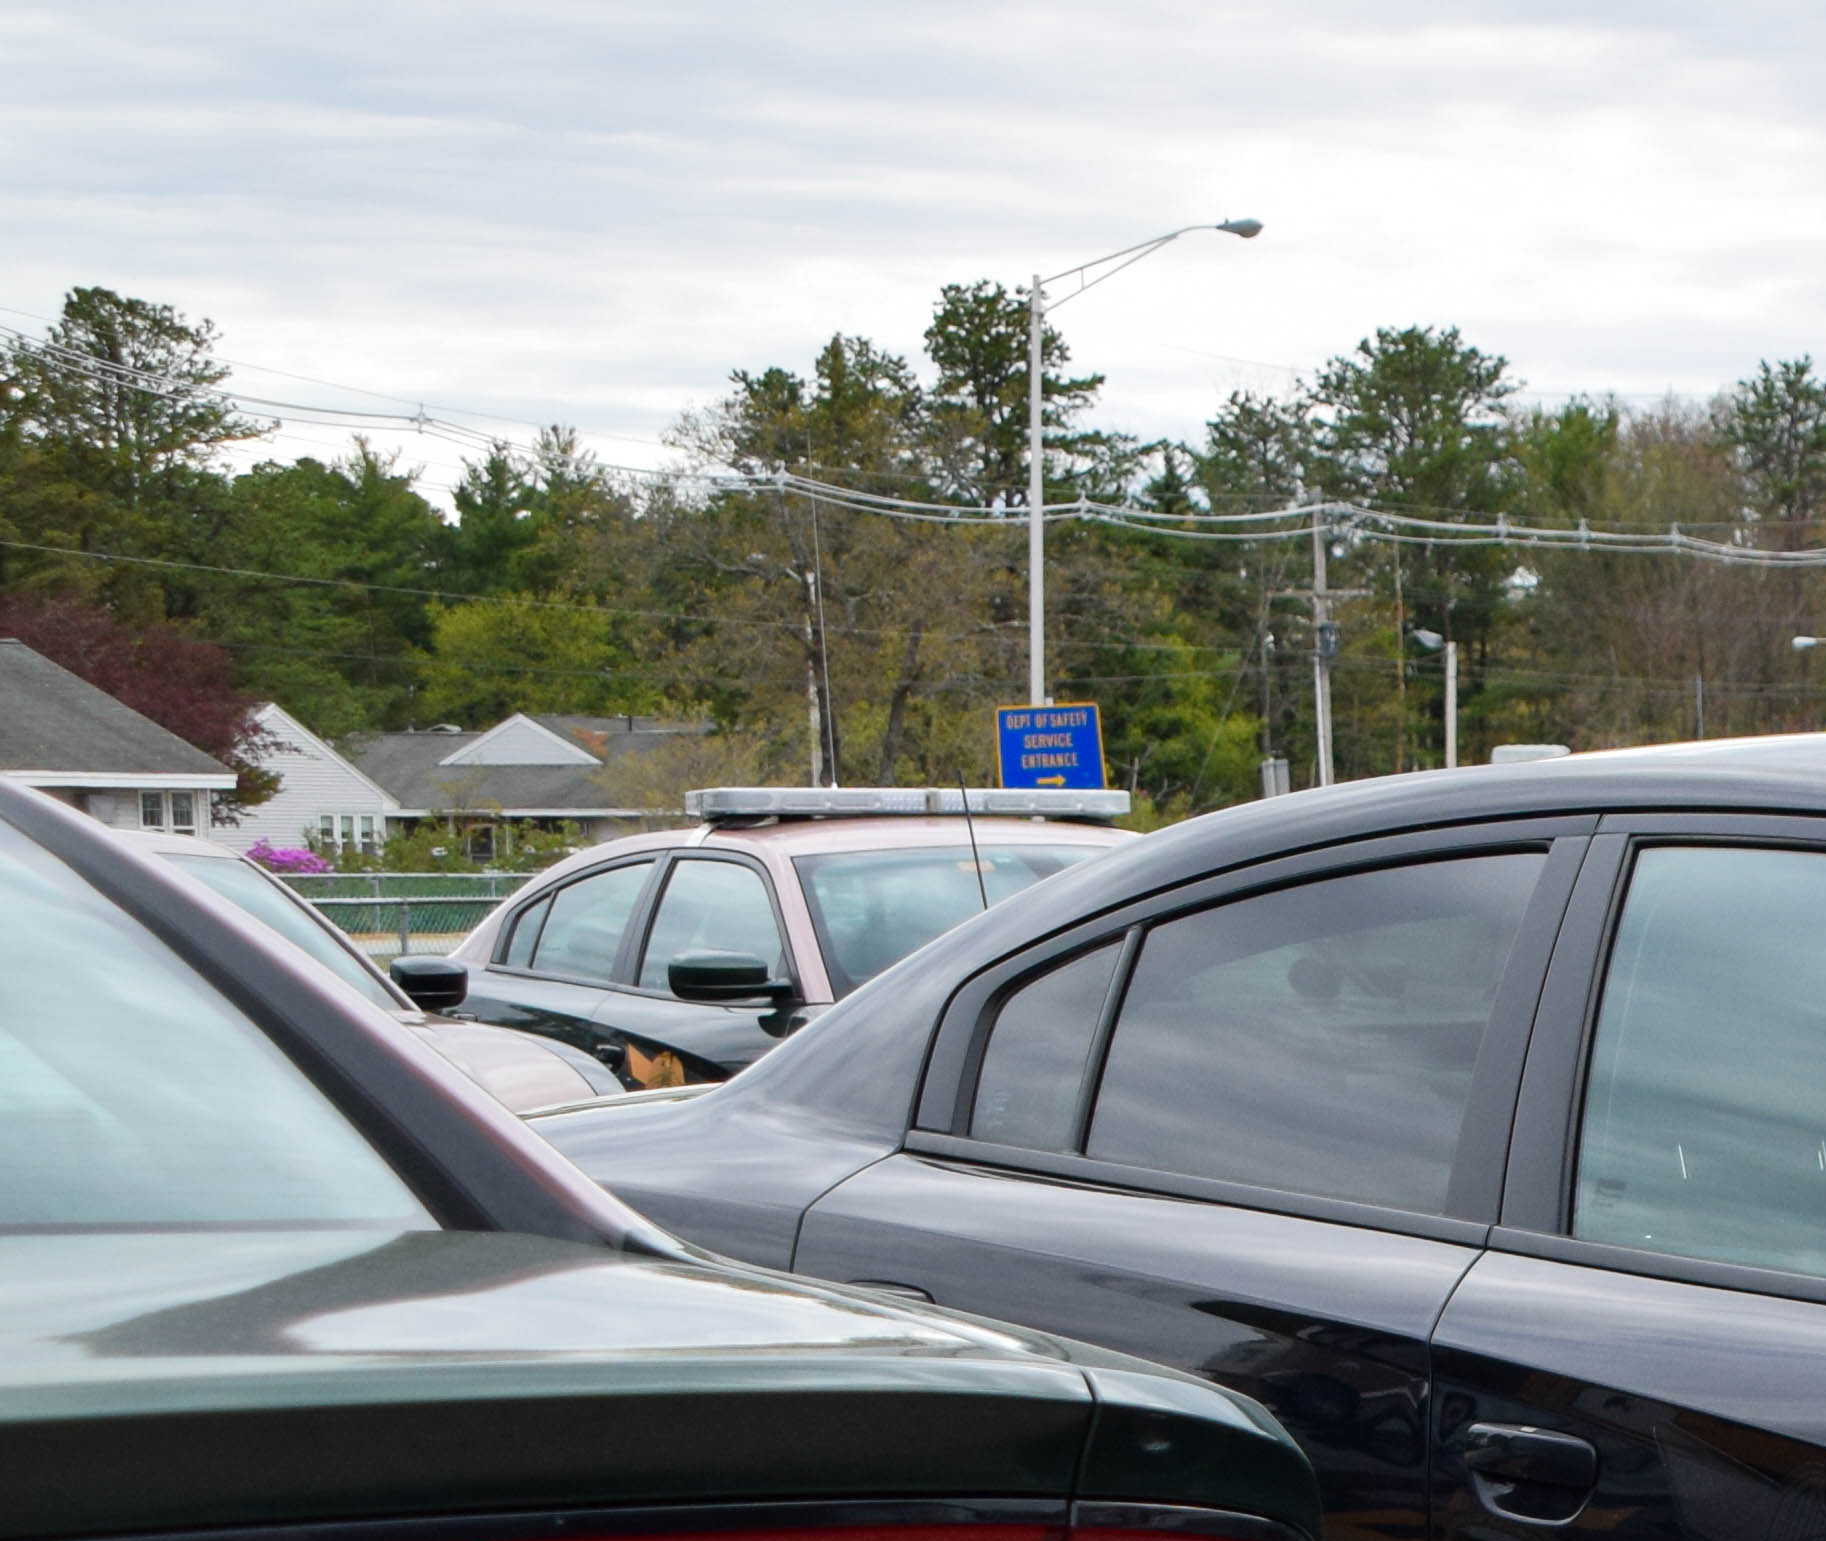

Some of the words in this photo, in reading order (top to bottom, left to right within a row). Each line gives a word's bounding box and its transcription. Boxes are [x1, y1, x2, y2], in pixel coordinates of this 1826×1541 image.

[1050, 710, 1087, 728] SAFETY
[1024, 733, 1073, 749] SERVICE
[1021, 752, 1078, 769] ENTRANCE
